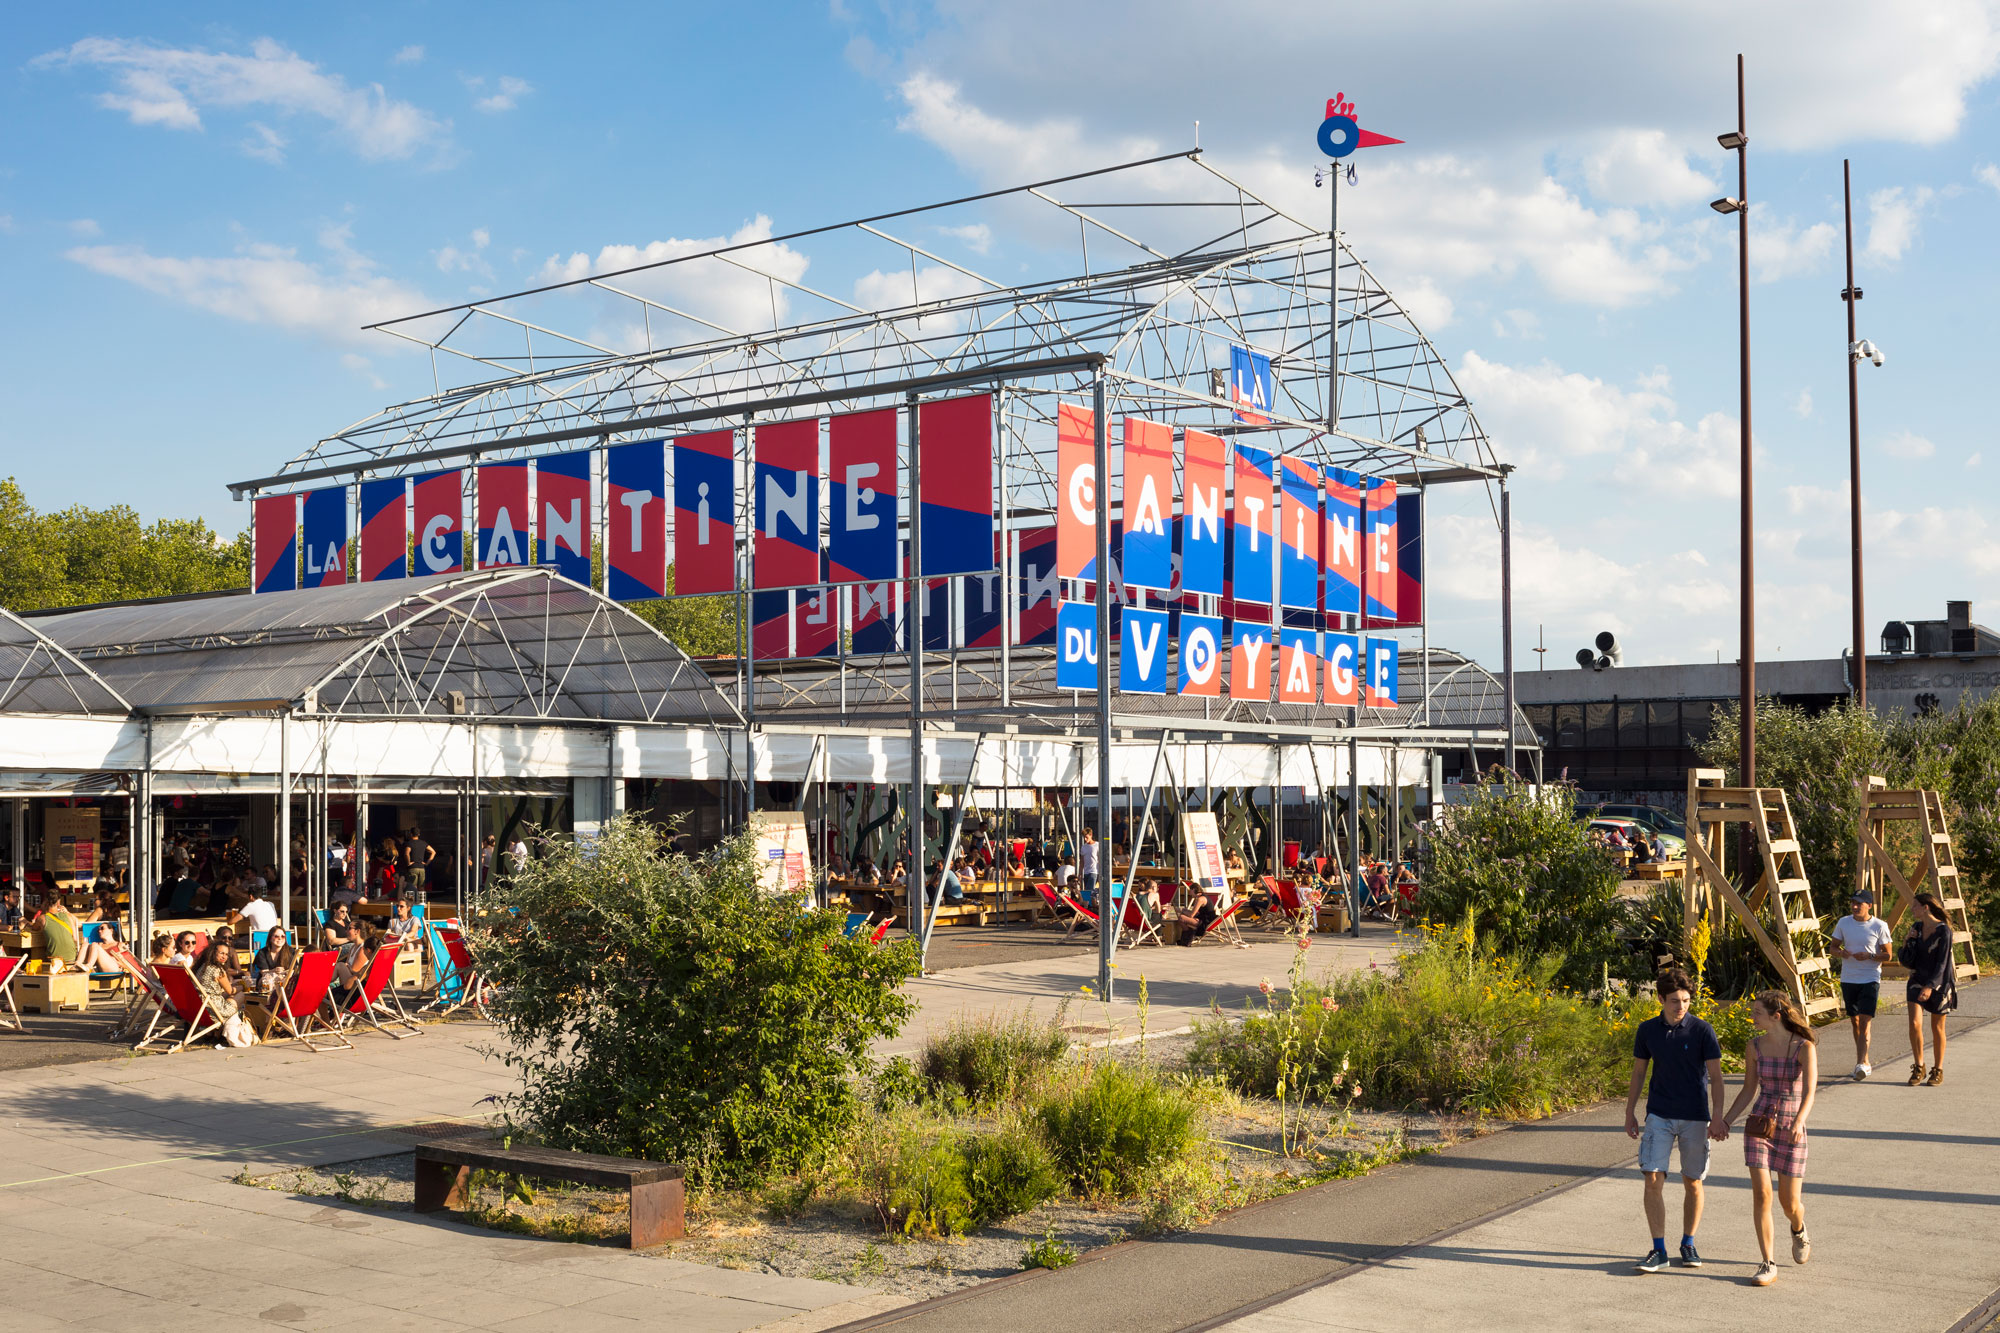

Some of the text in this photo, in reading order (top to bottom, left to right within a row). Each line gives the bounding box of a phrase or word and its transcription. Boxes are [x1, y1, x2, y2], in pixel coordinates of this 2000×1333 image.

[1238, 369, 1266, 407] LA
[307, 541, 342, 575] LA
[1065, 620, 1391, 698] DU VOYAGE
